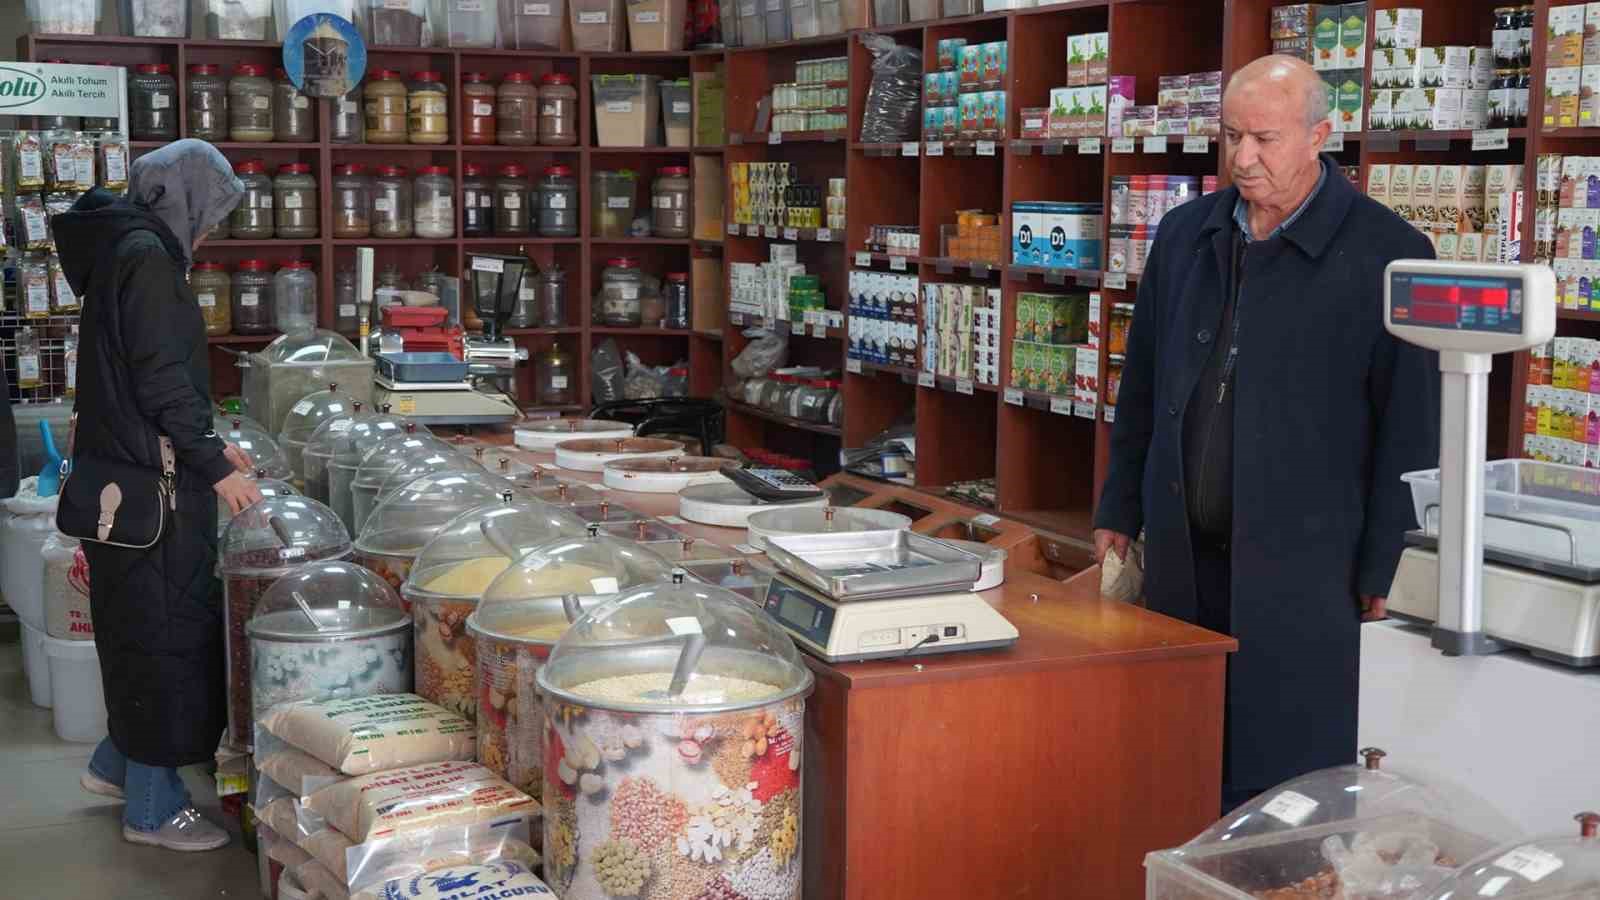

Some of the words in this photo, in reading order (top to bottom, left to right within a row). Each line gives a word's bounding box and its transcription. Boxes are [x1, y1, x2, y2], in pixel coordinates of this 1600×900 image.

[77, 77, 107, 86] Tohum
[1020, 230, 1031, 244] D1
[1051, 232, 1064, 246] D1
